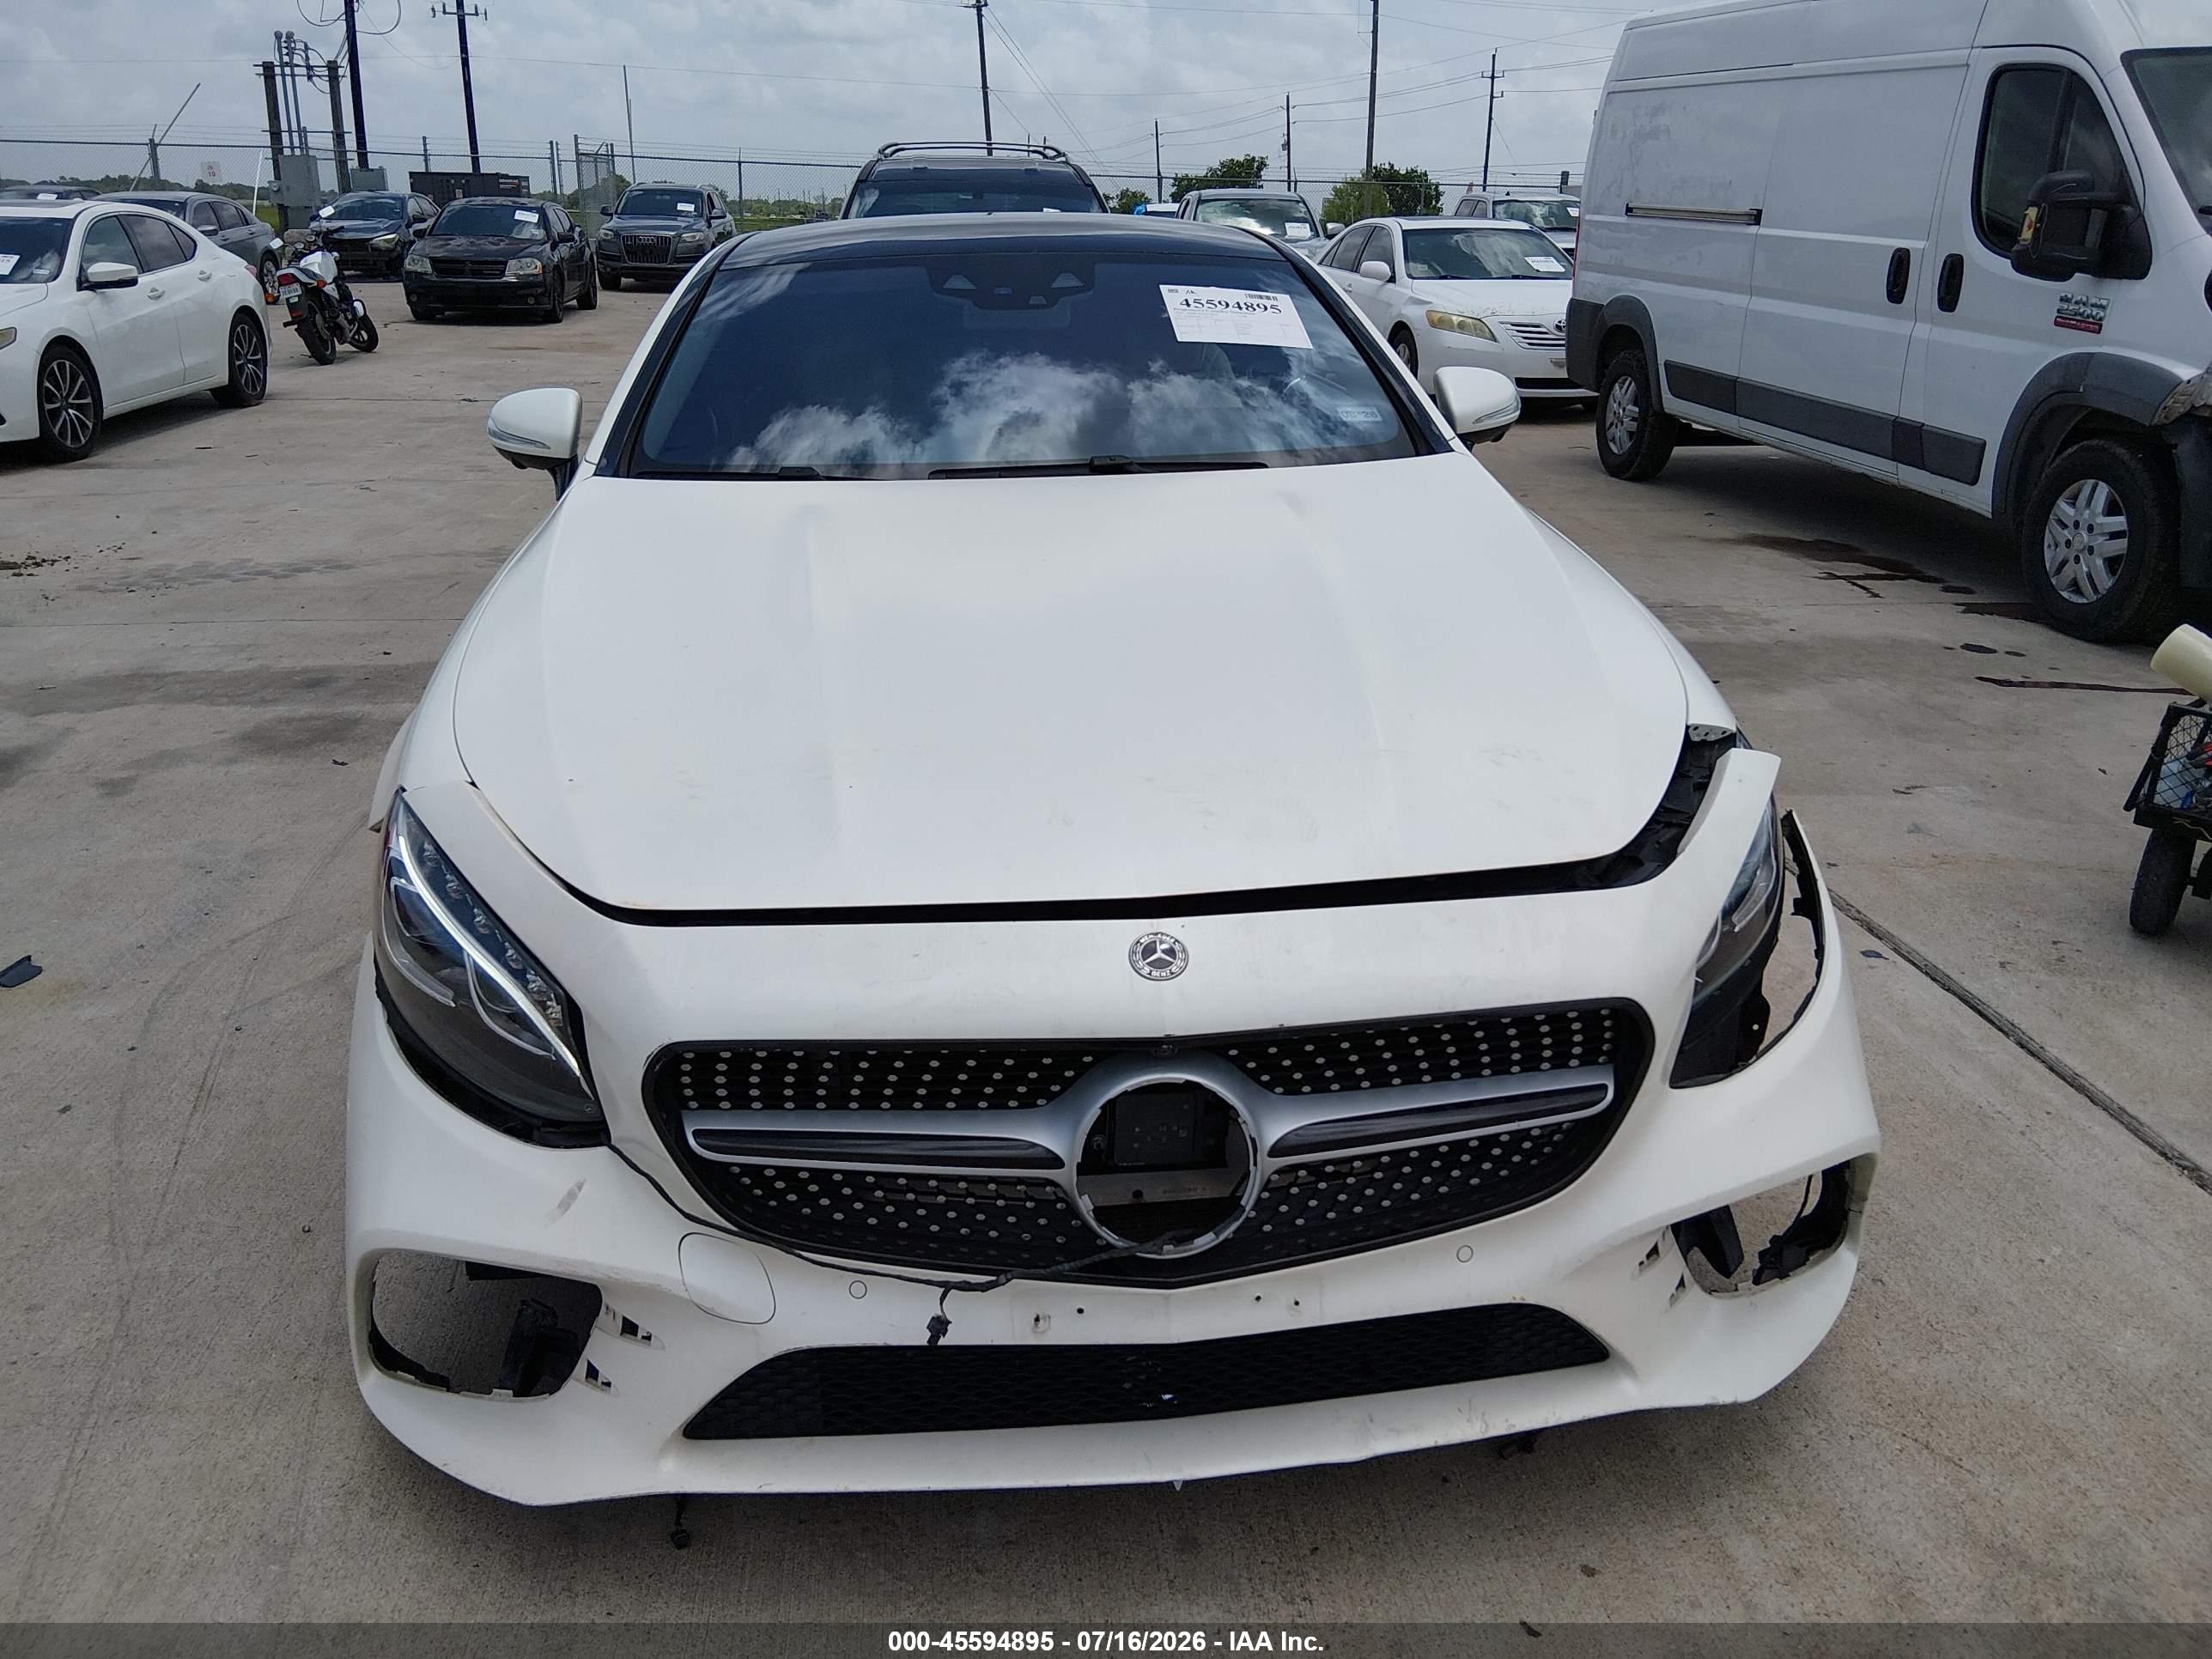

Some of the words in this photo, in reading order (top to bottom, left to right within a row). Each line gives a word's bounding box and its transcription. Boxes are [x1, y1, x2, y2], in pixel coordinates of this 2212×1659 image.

[1180, 298, 1282, 314] 45594895
[2059, 292, 2110, 309] RAM
[2057, 304, 2106, 322] 2500
